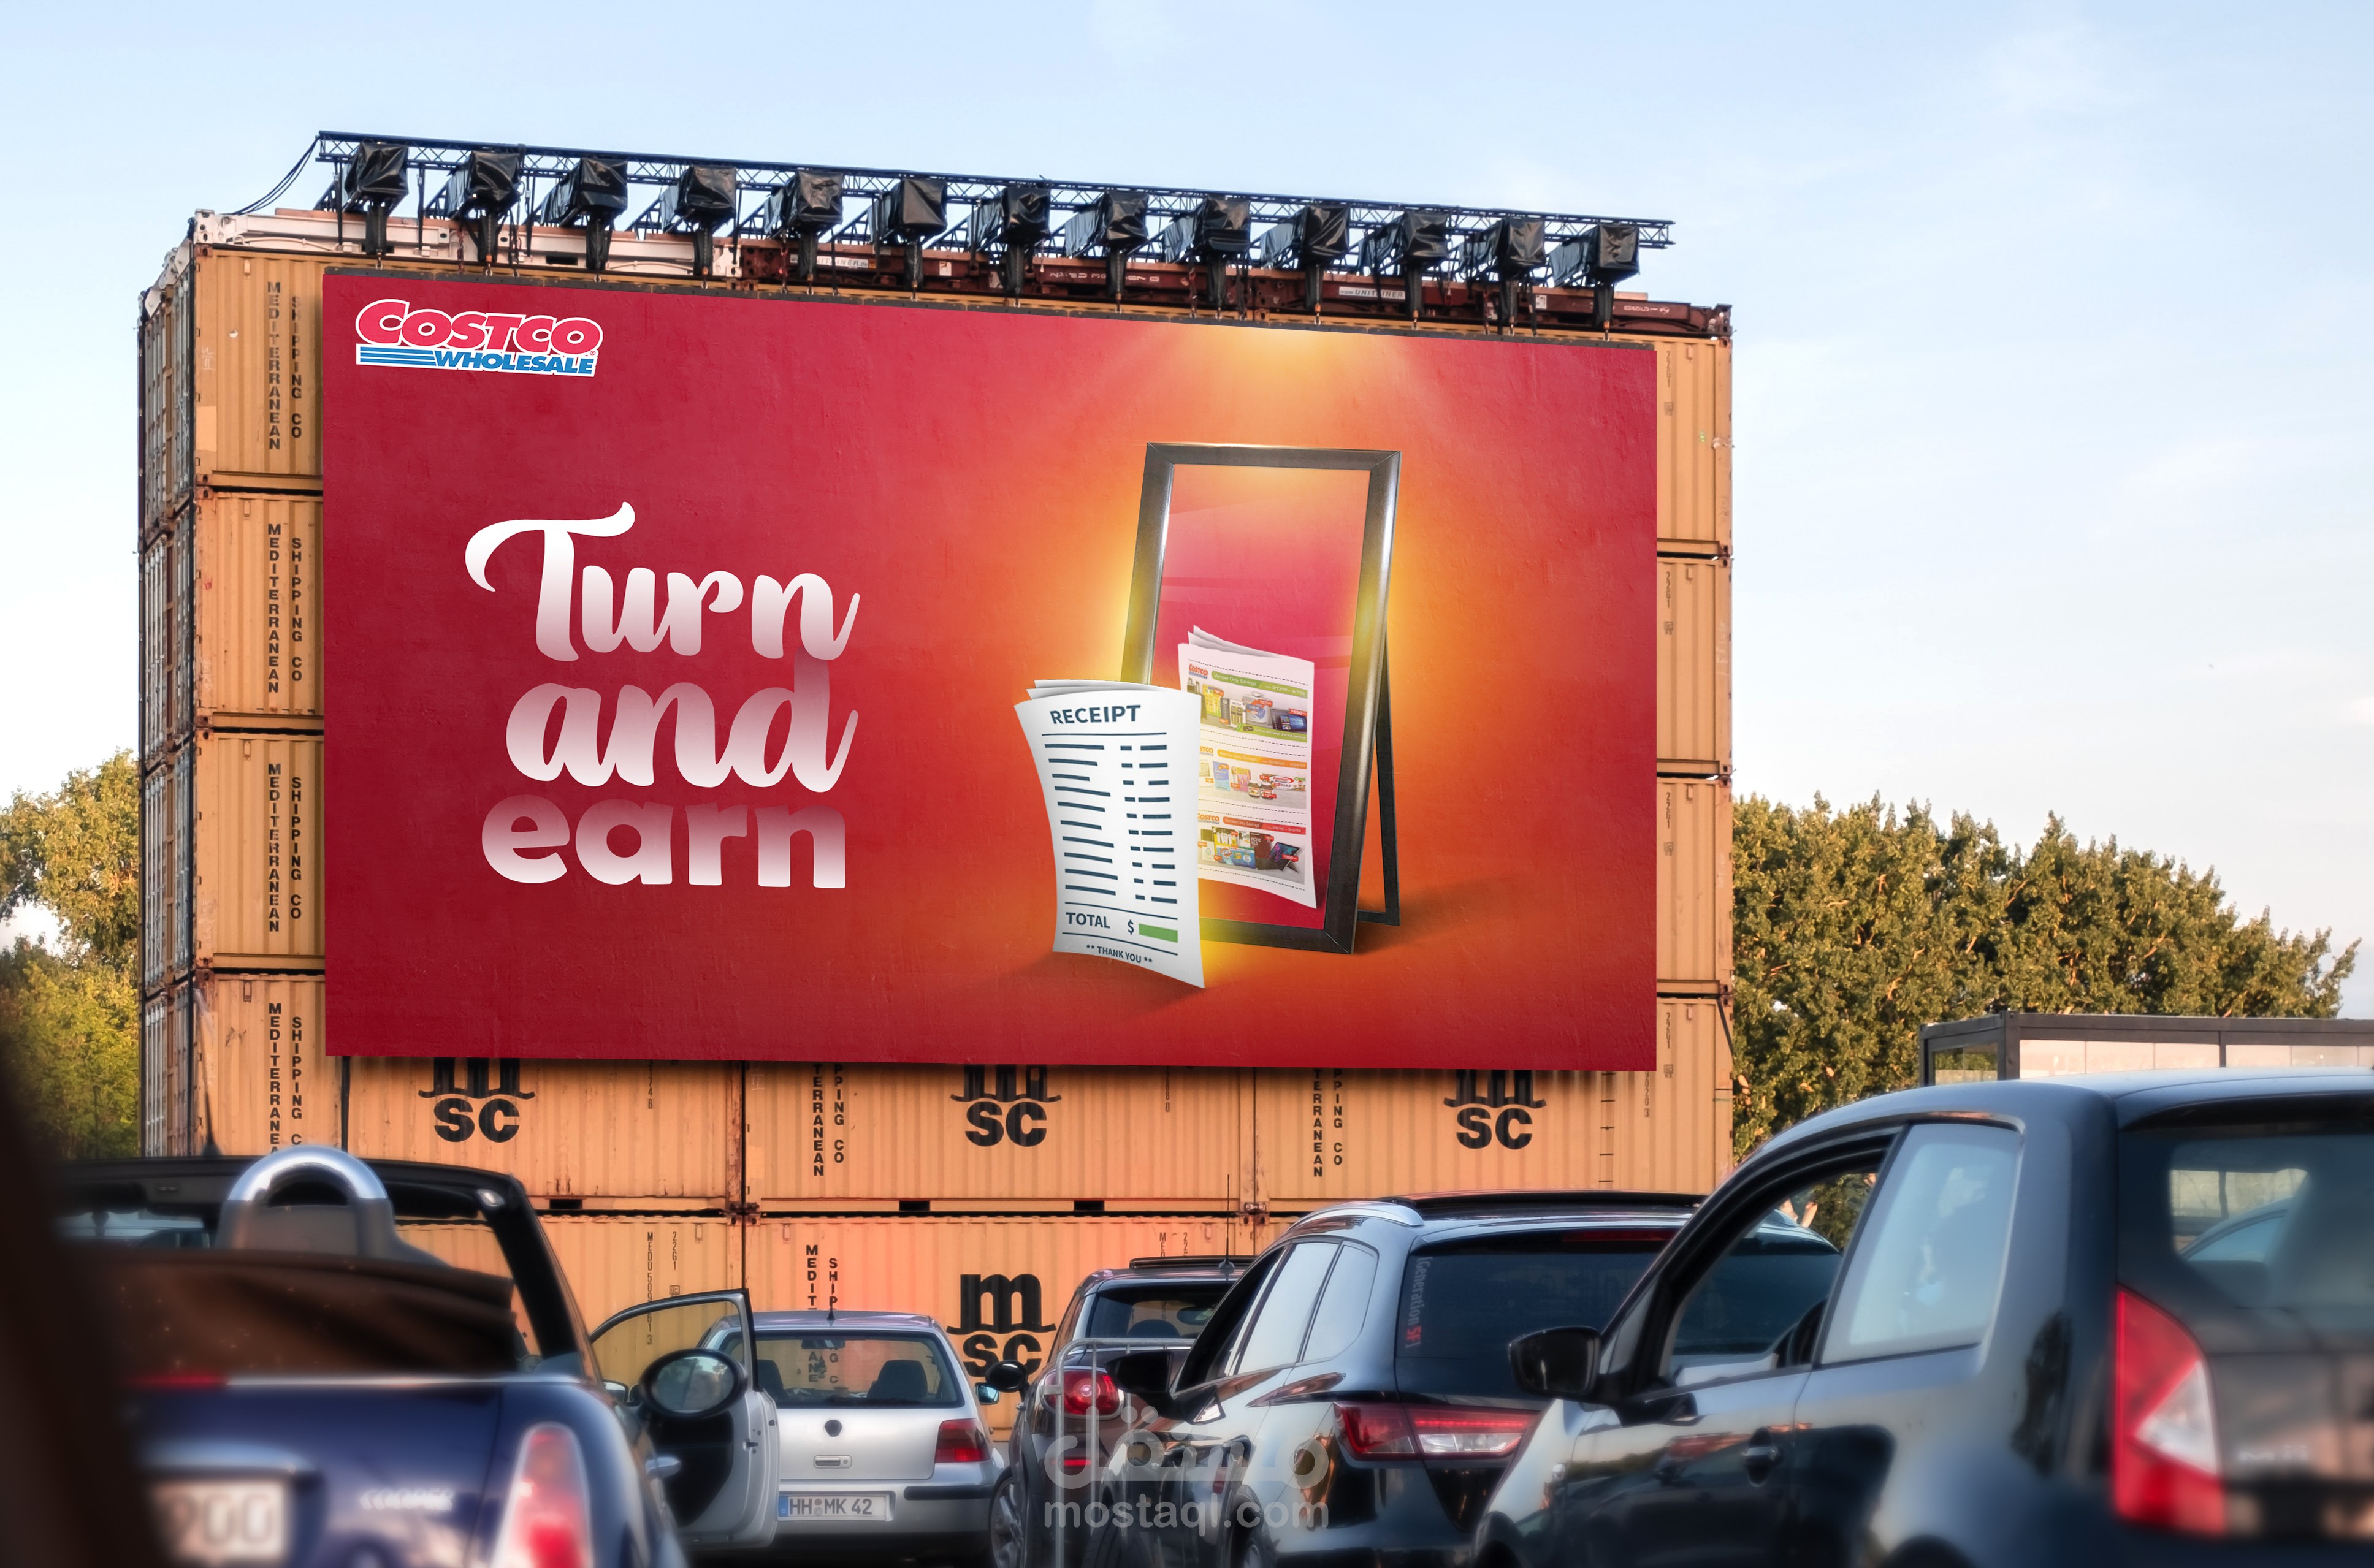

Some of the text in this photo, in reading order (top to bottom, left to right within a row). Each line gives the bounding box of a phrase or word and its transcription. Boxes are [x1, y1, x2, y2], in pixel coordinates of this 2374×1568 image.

[267, 282, 281, 450] MEDITERRANEAN
[291, 296, 303, 439] SHIPPING CO
[356, 299, 603, 356] COSTCO
[433, 350, 595, 375] WHOLESALE
[268, 523, 281, 693] MEDITERRANEAN
[291, 538, 303, 682] SHIPPING CO
[465, 501, 860, 661] Turn
[506, 645, 858, 793] and
[1050, 704, 1141, 725] RECEIPT
[1188, 663, 1208, 676] COSTCO
[268, 764, 281, 932] MEDITERRANEAN
[291, 777, 302, 919] SHIPPING CO
[482, 794, 846, 889] earn
[1066, 912, 1134, 935] TOTAL $
[1097, 946, 1142, 964] THANK YOU
[269, 1003, 281, 1154] MEDITERRANE
[291, 1016, 302, 1146] SHIPPING C
[812, 1064, 824, 1176] TERRANEAN
[833, 1064, 845, 1163] PPING CO
[1313, 1068, 1323, 1176] TERRANEAN
[1333, 1068, 1343, 1166] PPING CO
[790, 1498, 812, 1515] HH
[825, 1498, 847, 1515] MK
[851, 1498, 872, 1515] 42
